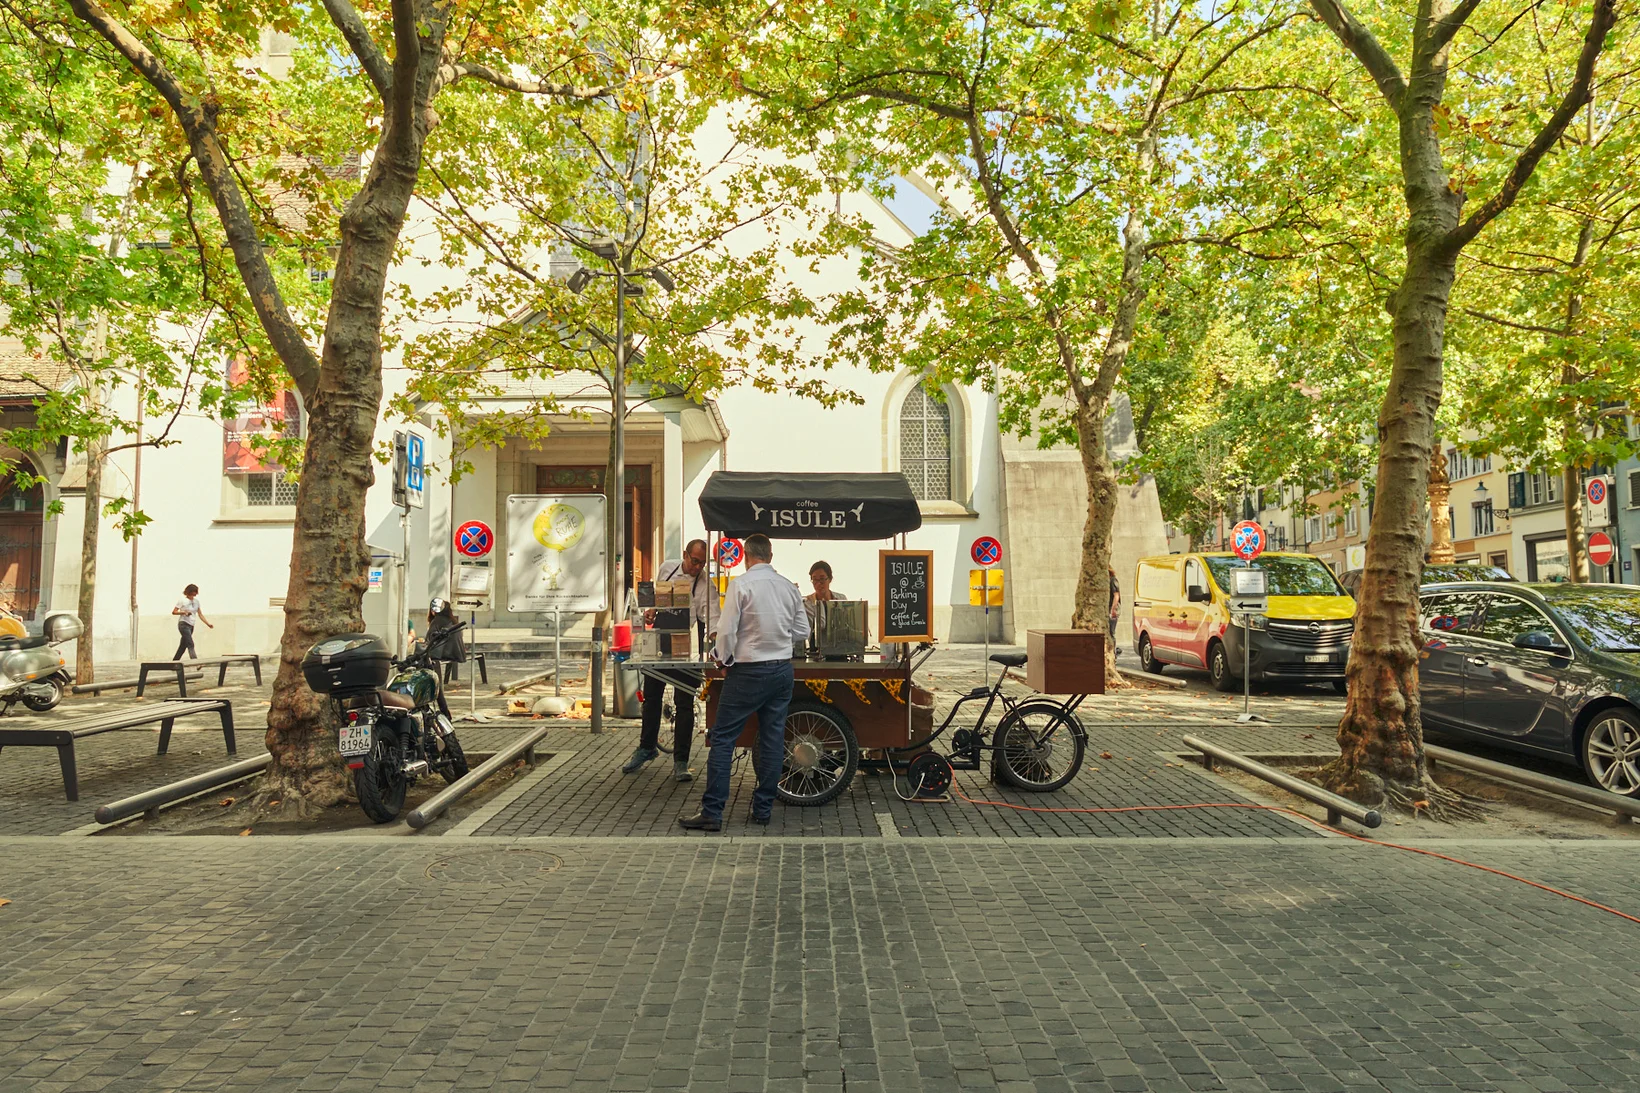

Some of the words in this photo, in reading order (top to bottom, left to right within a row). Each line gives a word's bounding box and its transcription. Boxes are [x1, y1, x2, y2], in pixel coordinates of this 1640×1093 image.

[413, 439, 421, 465] P
[796, 500, 819, 508] coffee
[555, 515, 578, 537] RUHE
[770, 509, 846, 529] ISULE
[890, 561, 925, 576] ISULE
[899, 577, 909, 589] @
[890, 587, 918, 603] Parking
[891, 600, 908, 614] Day
[890, 612, 910, 621] Coffee
[911, 611, 920, 621] for
[349, 728, 362, 738] ZH
[340, 738, 370, 750] 81964
